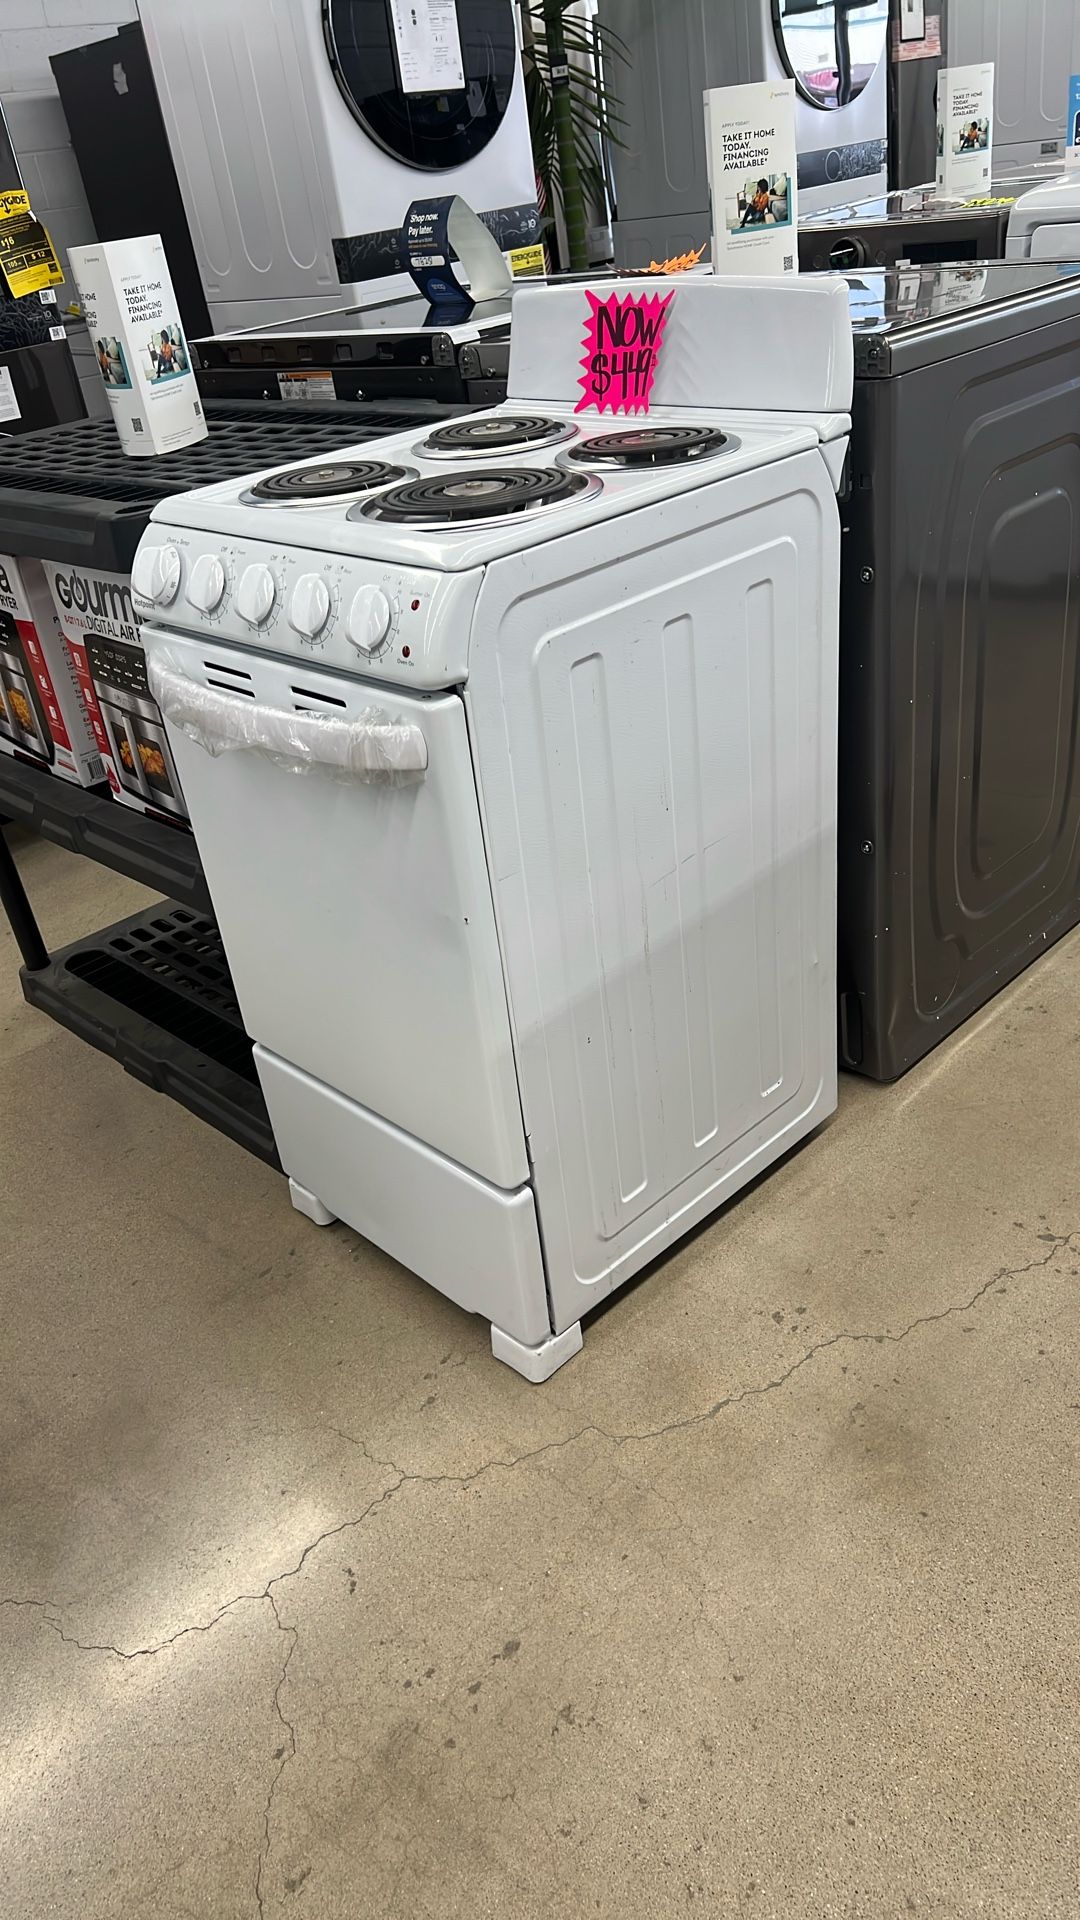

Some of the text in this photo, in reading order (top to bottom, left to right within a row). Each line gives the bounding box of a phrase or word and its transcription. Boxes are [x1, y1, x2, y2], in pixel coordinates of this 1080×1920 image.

[722, 128, 775, 143] TAKE IT HOME
[723, 141, 751, 152] TODAY.
[723, 148, 769, 161] FINANCING
[410, 213, 425, 223] Shop
[408, 226, 419, 237] Pay
[123, 281, 162, 296] TAKE IT HOME
[128, 300, 162, 315] FINANCING
[597, 306, 666, 350] NOW
[134, 598, 156, 610] Hotpoint
[86, 615, 119, 638] DIGITAL
[120, 624, 136, 642] AIR
[397, 658, 408, 666] Oven
